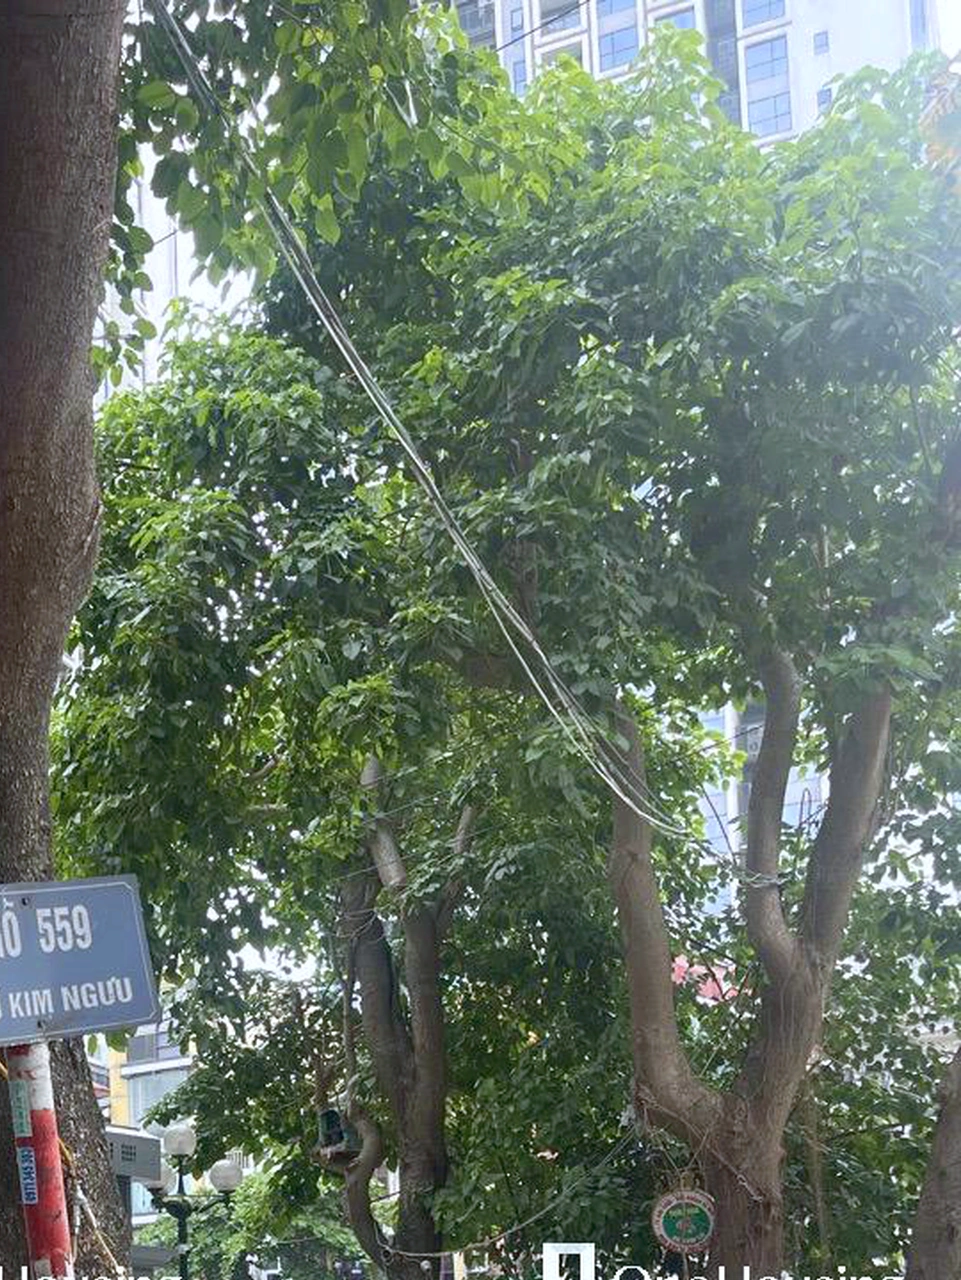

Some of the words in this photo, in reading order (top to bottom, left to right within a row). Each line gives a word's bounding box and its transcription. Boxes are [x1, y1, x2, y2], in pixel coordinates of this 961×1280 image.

[36, 904, 93, 953] 559
[8, 988, 55, 1018] KIM
[60, 976, 133, 1012] NGƯU
